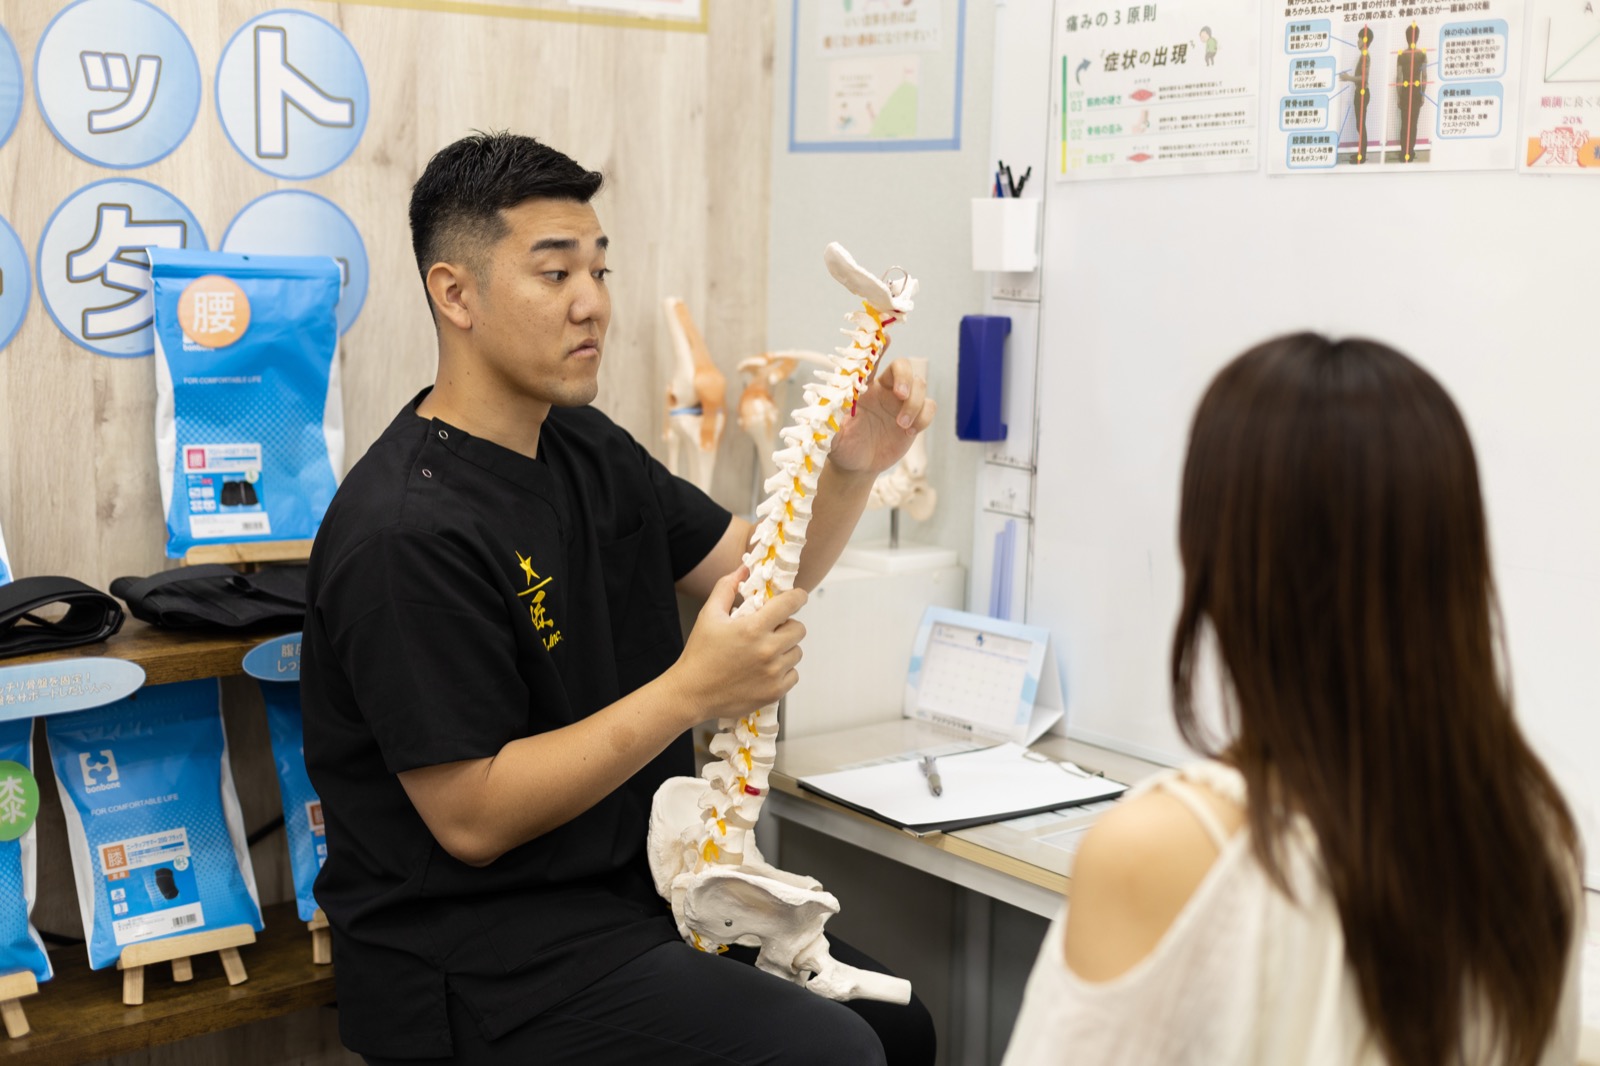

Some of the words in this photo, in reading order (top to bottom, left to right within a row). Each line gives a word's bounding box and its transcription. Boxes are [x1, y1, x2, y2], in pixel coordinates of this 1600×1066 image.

[1104, 43, 1188, 72] 症状の出現
[192, 291, 236, 334] 腰
[85, 781, 121, 794] bonbone
[91, 807, 107, 816] FOR
[108, 796, 162, 813] COMFORTABLE
[163, 793, 179, 801] LIFE
